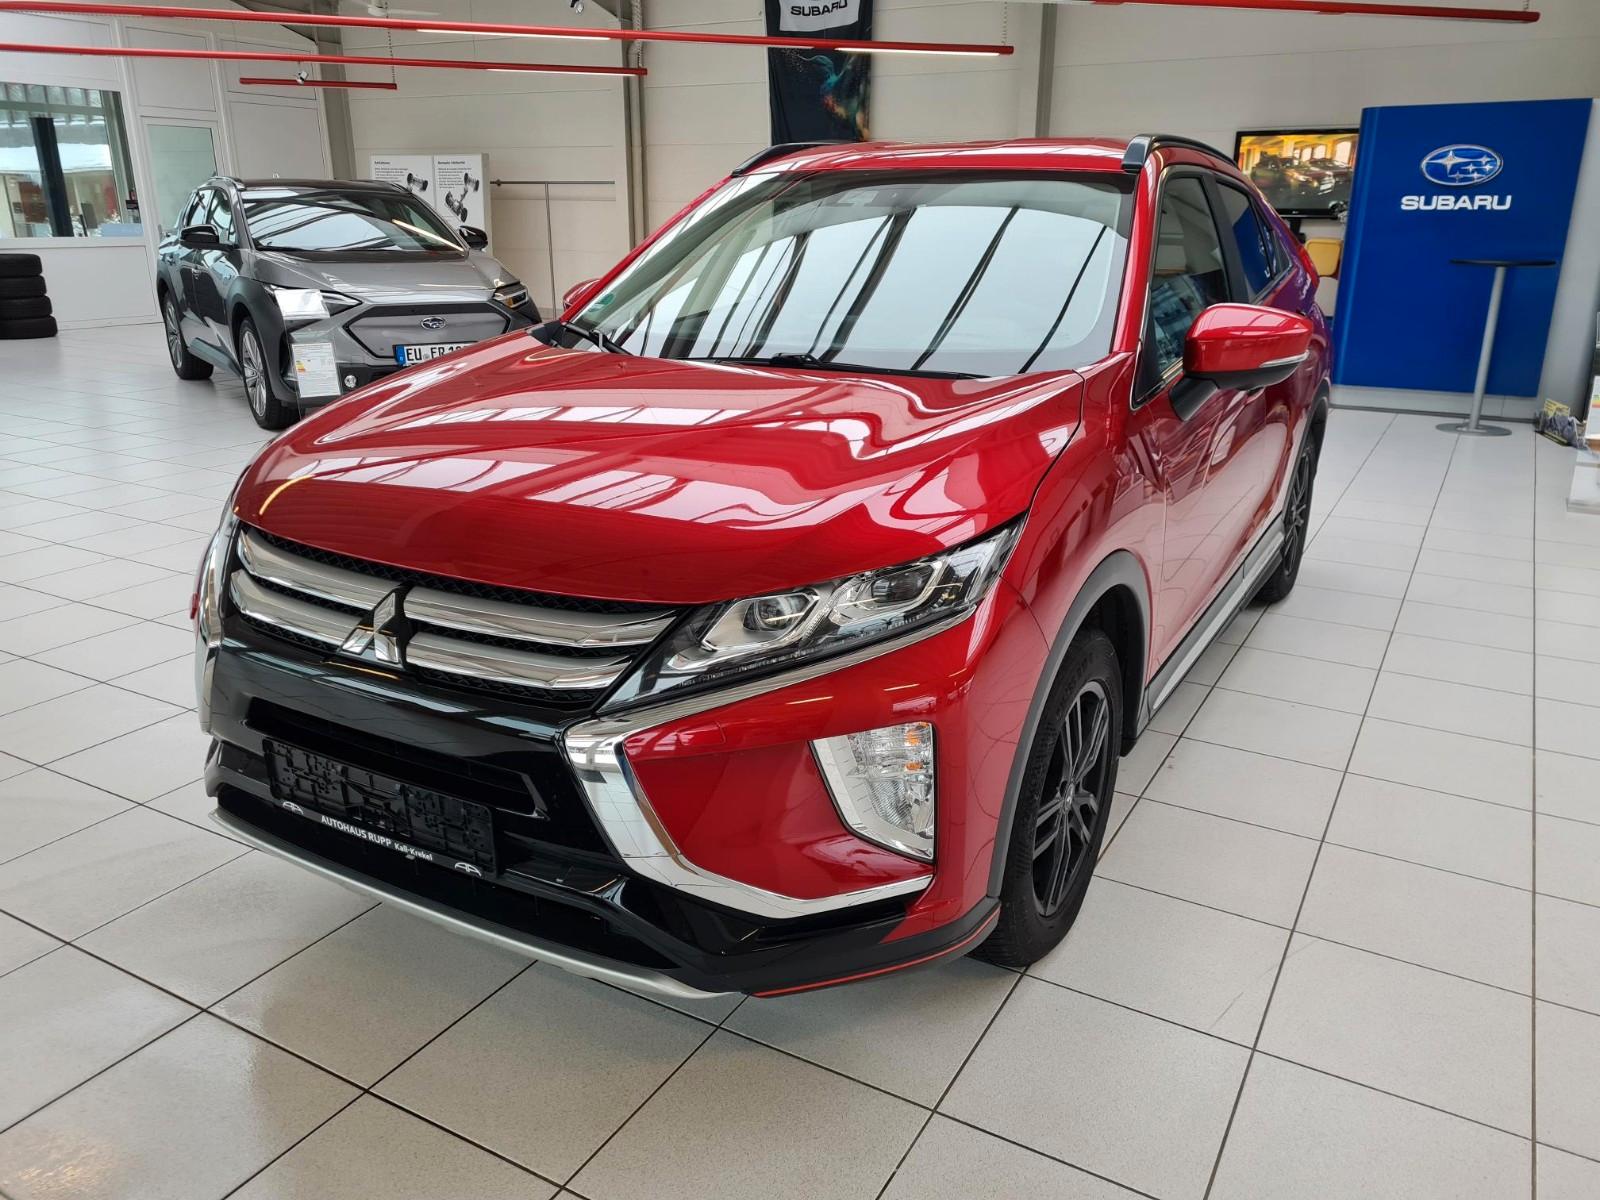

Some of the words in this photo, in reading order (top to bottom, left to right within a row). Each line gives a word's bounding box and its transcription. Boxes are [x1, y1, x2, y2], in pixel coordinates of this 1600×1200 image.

[791, 0, 848, 16] SUBARU
[1401, 195, 1512, 210] SUBARU
[406, 348, 422, 361] EU
[321, 815, 367, 839] AUTOHAUS
[368, 832, 392, 847] RUPP
